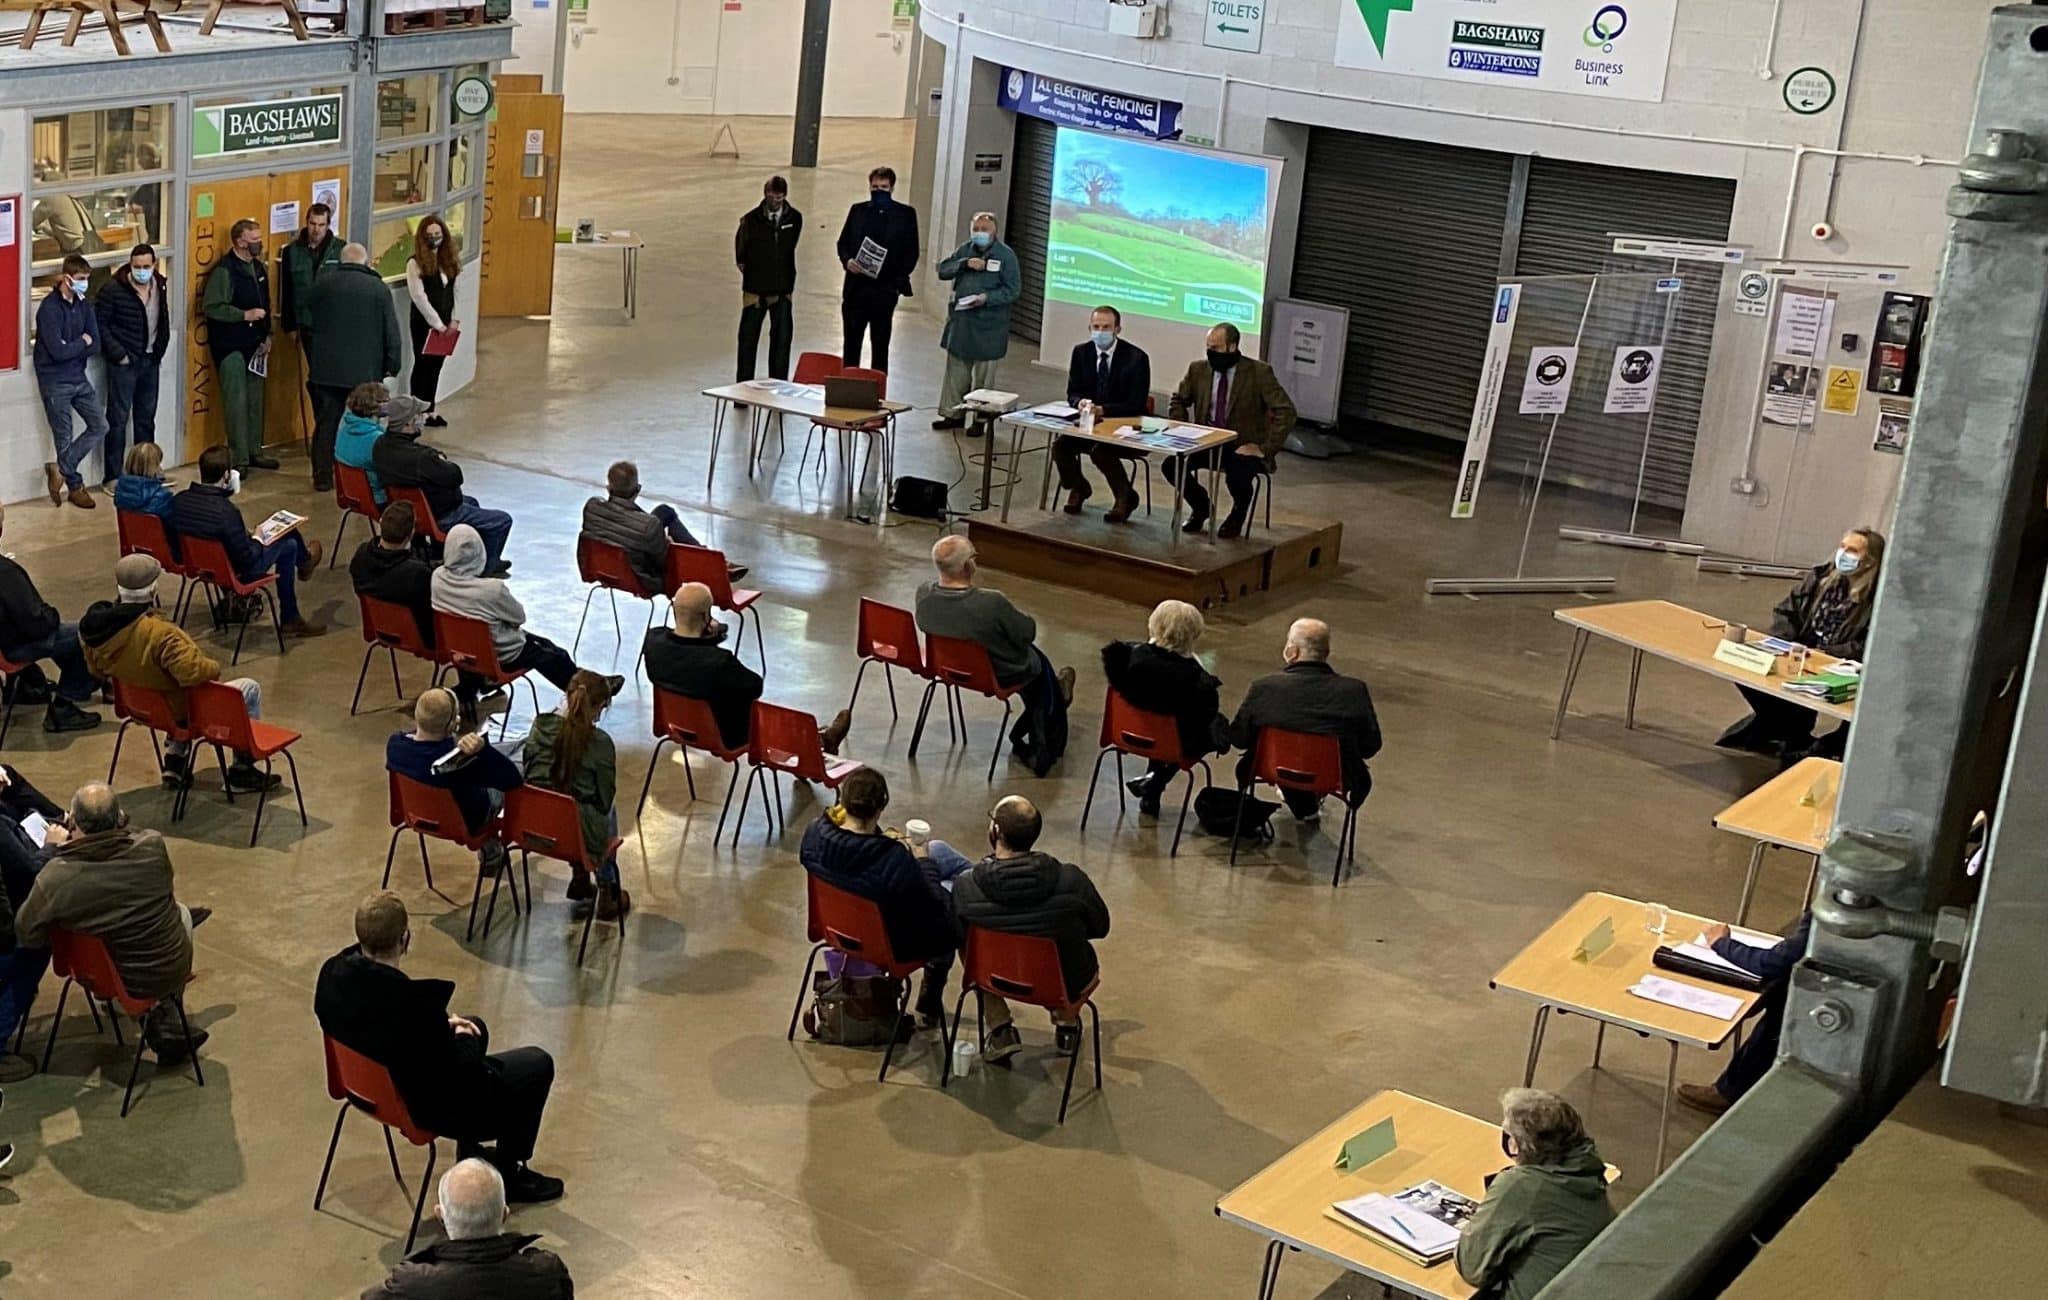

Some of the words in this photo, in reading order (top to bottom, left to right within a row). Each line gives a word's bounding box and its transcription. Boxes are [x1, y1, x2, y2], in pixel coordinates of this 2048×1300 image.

[1211, 1, 1260, 20] TOILETS
[1457, 23, 1540, 44] BAGSHAWS
[1463, 51, 1538, 70] WINTERTONS
[1575, 59, 1624, 75] Business
[1585, 75, 1609, 87] Link
[464, 87, 480, 96] PAY
[1053, 83, 1099, 105] ELECTRIC
[1101, 94, 1154, 116] FENCING
[229, 103, 331, 136] BAGSHAWS
[1094, 108, 1102, 116] In
[1103, 110, 1113, 119] Or
[1114, 112, 1128, 123] Out
[245, 136, 260, 146] Land
[262, 134, 287, 145] Property
[192, 359, 210, 416] PAY
